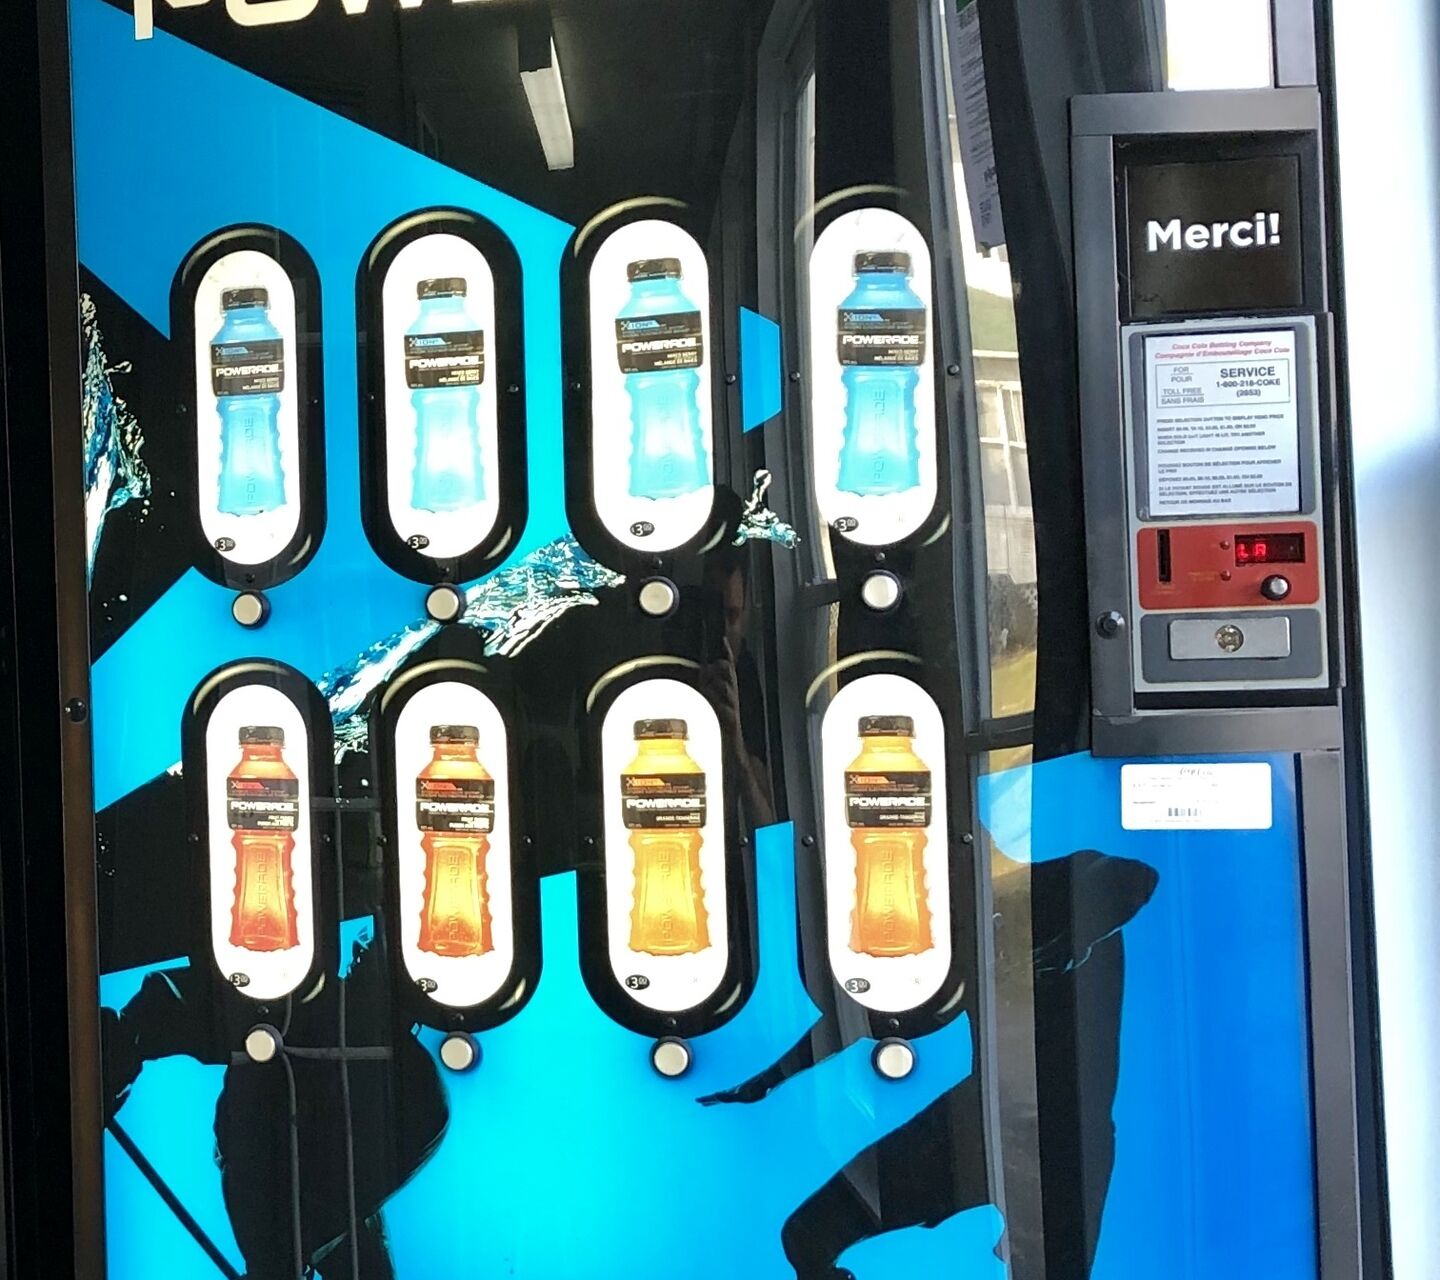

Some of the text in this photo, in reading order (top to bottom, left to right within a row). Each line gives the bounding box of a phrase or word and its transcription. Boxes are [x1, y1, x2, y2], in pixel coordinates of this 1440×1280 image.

[1147, 212, 1280, 252] Merci!
[621, 337, 697, 353] POWERADE
[842, 334, 919, 345] POWERADE
[216, 364, 279, 377] POWERADE
[1220, 366, 1275, 379] SERVICE
